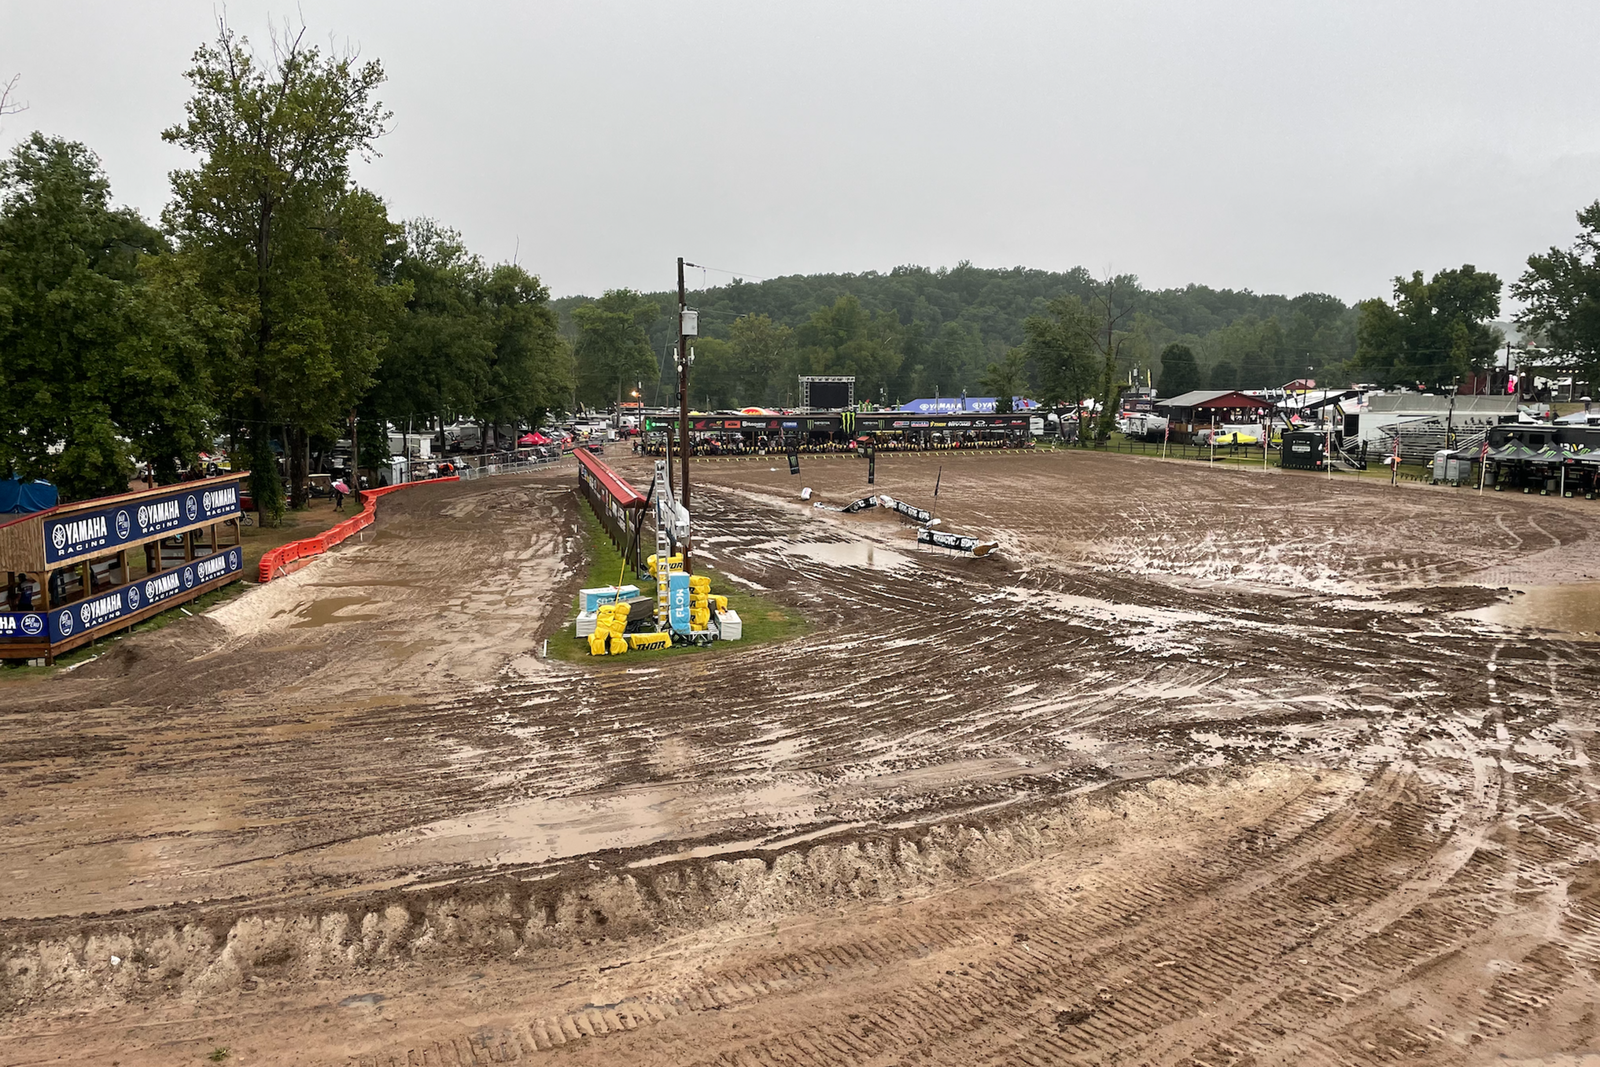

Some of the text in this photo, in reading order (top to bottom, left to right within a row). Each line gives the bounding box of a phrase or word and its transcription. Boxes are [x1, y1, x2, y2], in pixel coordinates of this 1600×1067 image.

[210, 487, 237, 509] YAMAHA
[147, 500, 180, 524] YAMAHA
[206, 505, 236, 516] RACING
[65, 516, 108, 545] YAMAHA
[142, 519, 178, 534] RACING
[58, 539, 106, 556] RACING
[203, 555, 226, 575] YAMAHA
[153, 572, 180, 595] YAMAHA
[200, 570, 225, 583] RACING
[149, 588, 179, 603] RACING
[90, 593, 122, 619] YAMAHA
[85, 611, 121, 628] RACING
[635, 641, 666, 651] THOR
